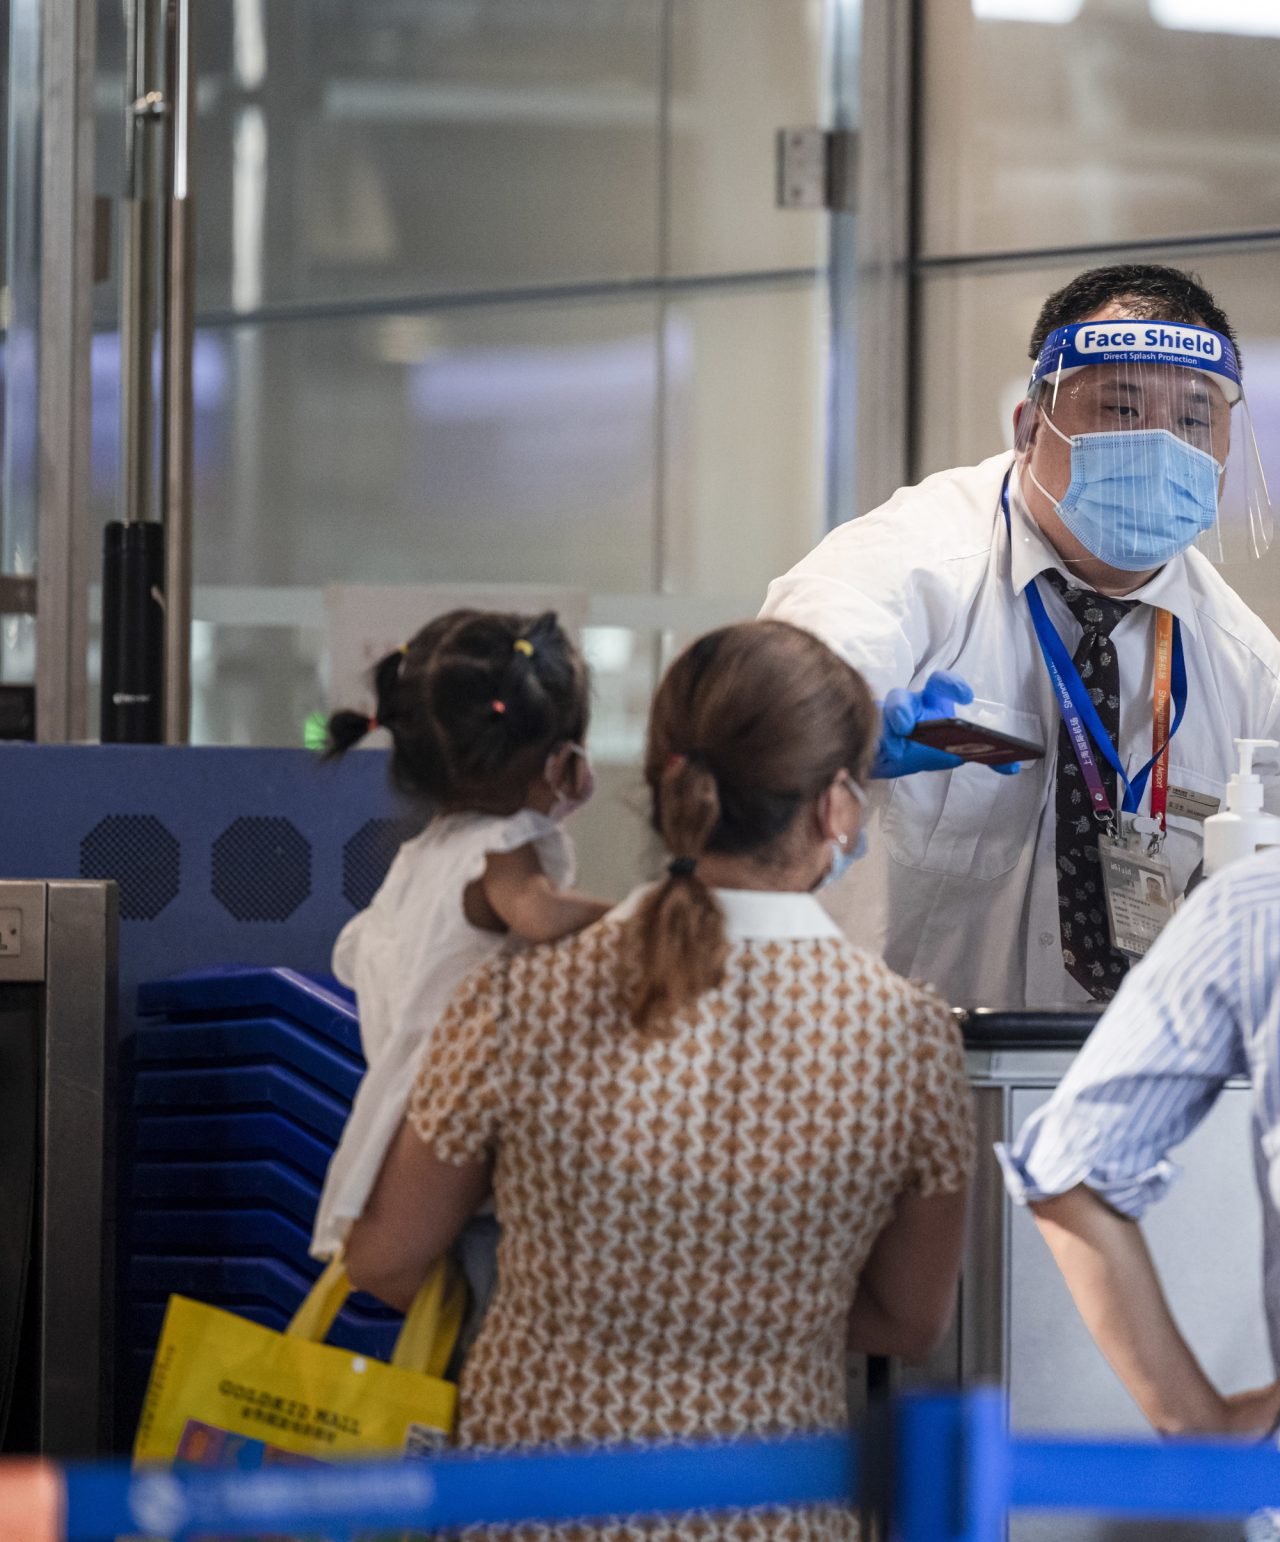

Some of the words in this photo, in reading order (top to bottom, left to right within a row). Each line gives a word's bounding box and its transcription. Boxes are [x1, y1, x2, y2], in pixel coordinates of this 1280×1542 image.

[1084, 330, 1136, 348] Face
[1144, 328, 1214, 355] Shield
[1103, 352, 1127, 360] Direct
[1129, 352, 1156, 361] Splash
[1158, 353, 1198, 365] Protection
